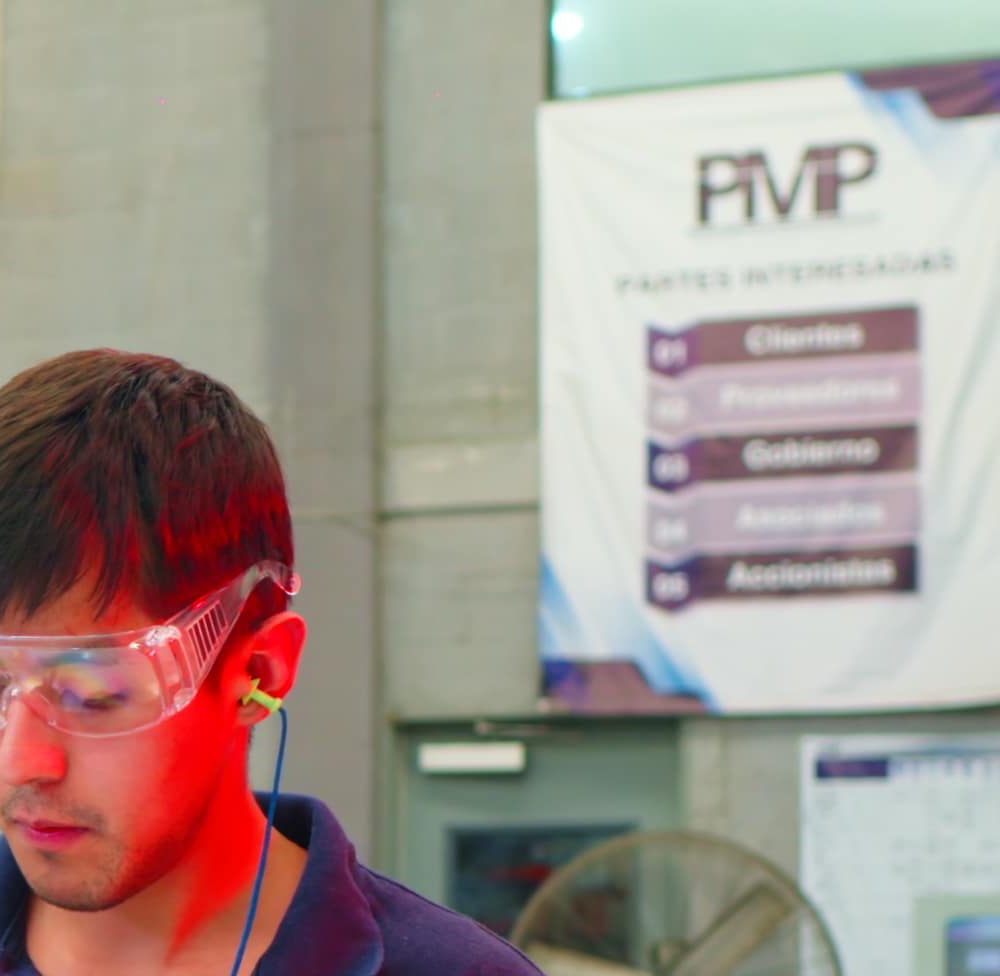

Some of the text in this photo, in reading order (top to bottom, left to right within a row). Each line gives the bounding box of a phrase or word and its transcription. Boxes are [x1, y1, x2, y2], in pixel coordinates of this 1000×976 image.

[614, 251, 956, 295] PARTES INTERESADAS
[653, 322, 864, 368] 01 Clientes
[742, 438, 880, 471] Gobierno
[726, 557, 897, 592] Accionistas
